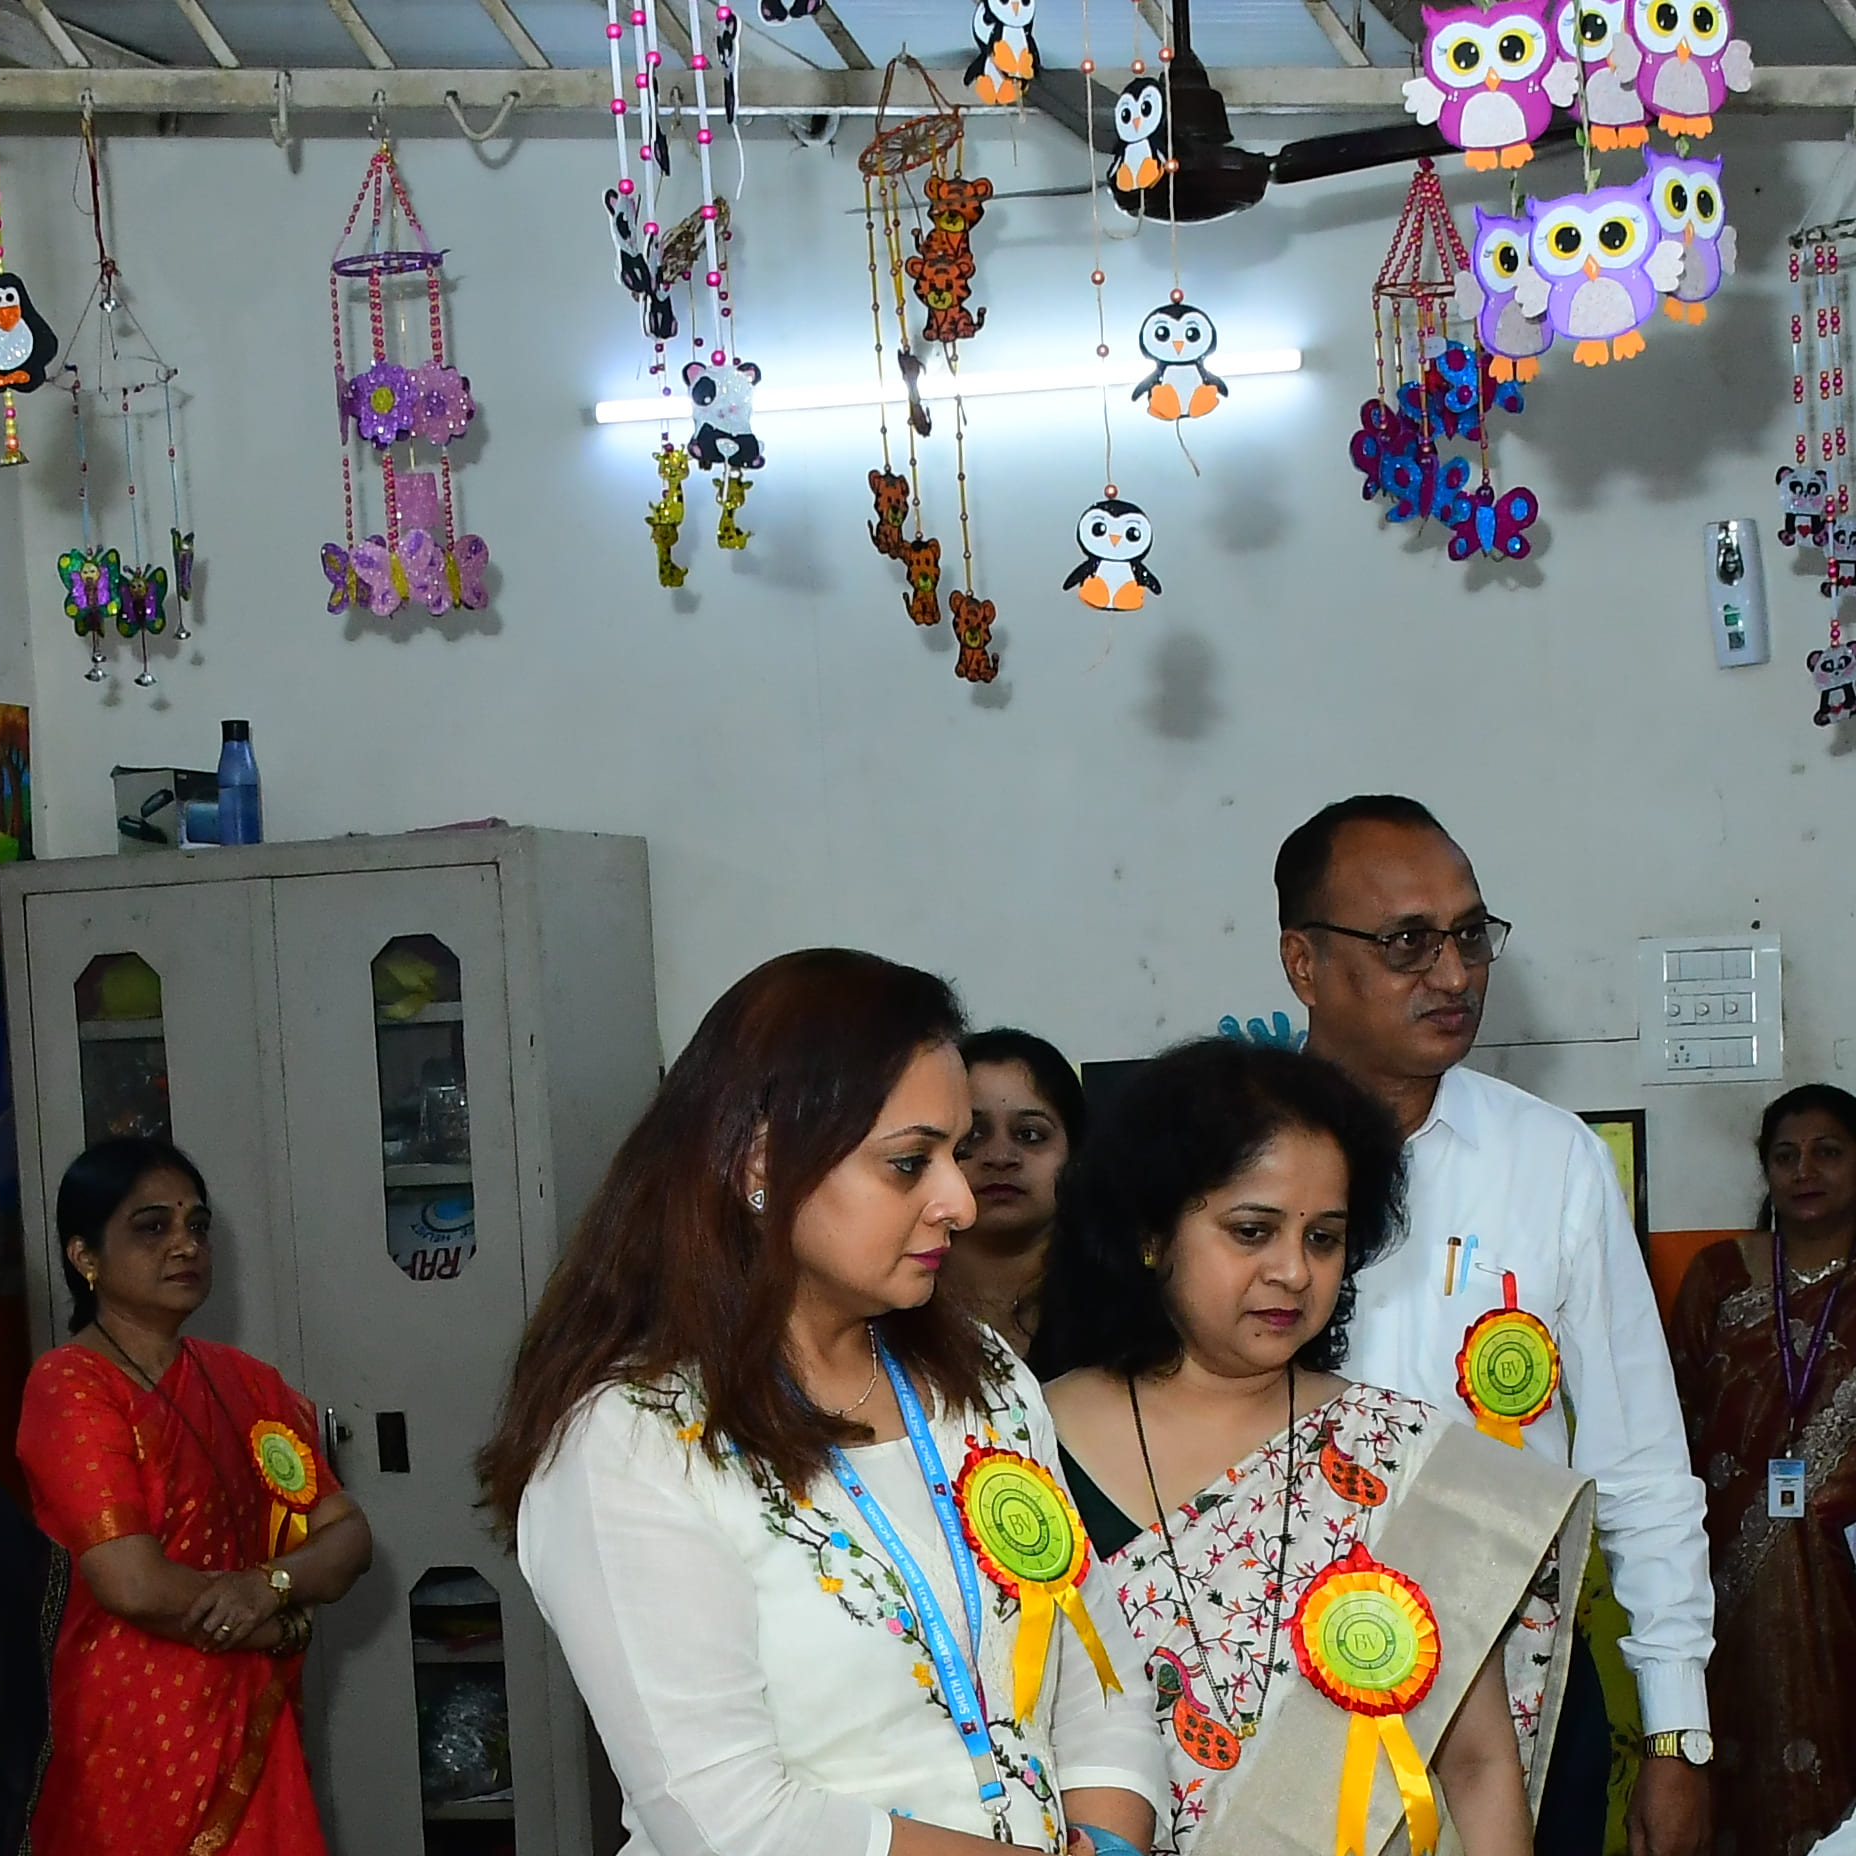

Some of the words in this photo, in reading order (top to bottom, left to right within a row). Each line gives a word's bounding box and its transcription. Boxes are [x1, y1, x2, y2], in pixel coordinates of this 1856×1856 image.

[902, 1391, 923, 1442] ENGLISH
[917, 1440, 939, 1477] SCHOOL
[865, 1502, 892, 1541] SCHOOL
[1008, 1511, 1033, 1536] BV
[888, 1541, 921, 1585] ENGLISH
[950, 1534, 974, 1592] KARAMSHI
[916, 1586, 935, 1620] KANJI
[929, 1620, 958, 1678] KARAMSHI
[1352, 1632, 1380, 1651] BV
[949, 1678, 971, 1715] SHETH
